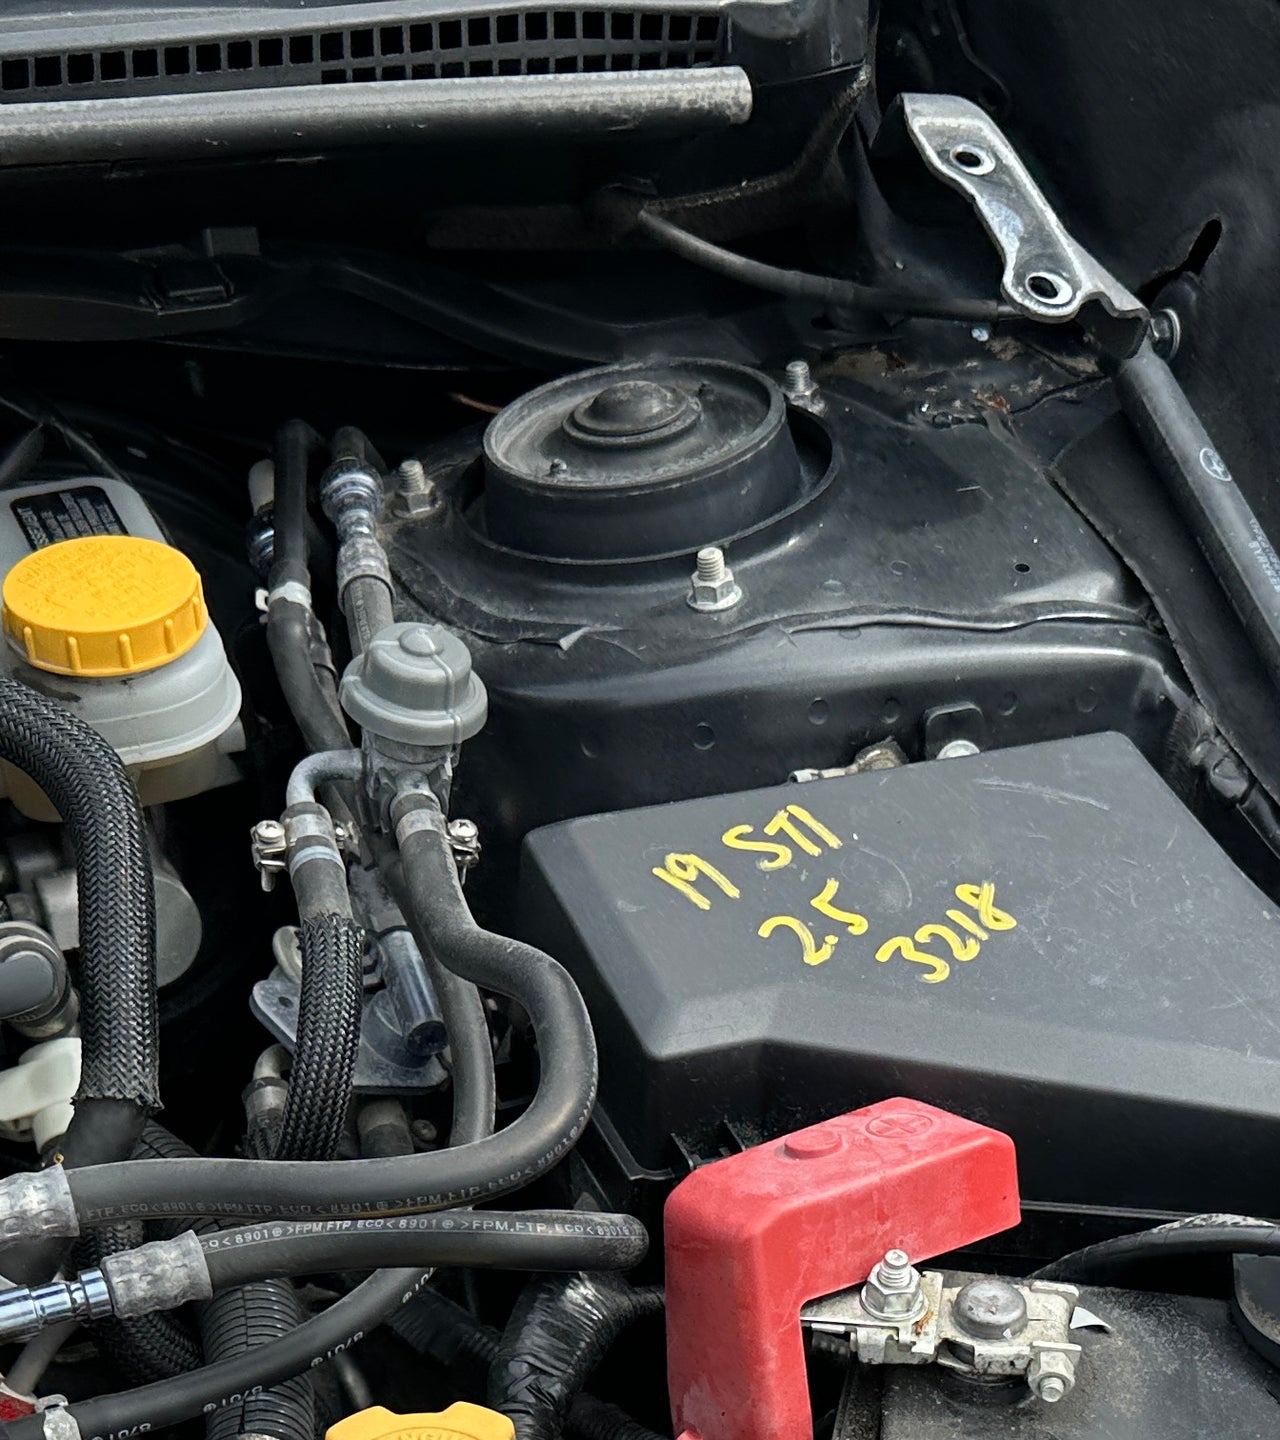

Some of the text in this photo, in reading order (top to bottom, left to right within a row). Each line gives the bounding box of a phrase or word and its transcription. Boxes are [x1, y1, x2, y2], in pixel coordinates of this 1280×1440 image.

[652, 852, 740, 910] 19
[758, 878, 868, 966] 2.5
[875, 881, 1017, 983] 3218
